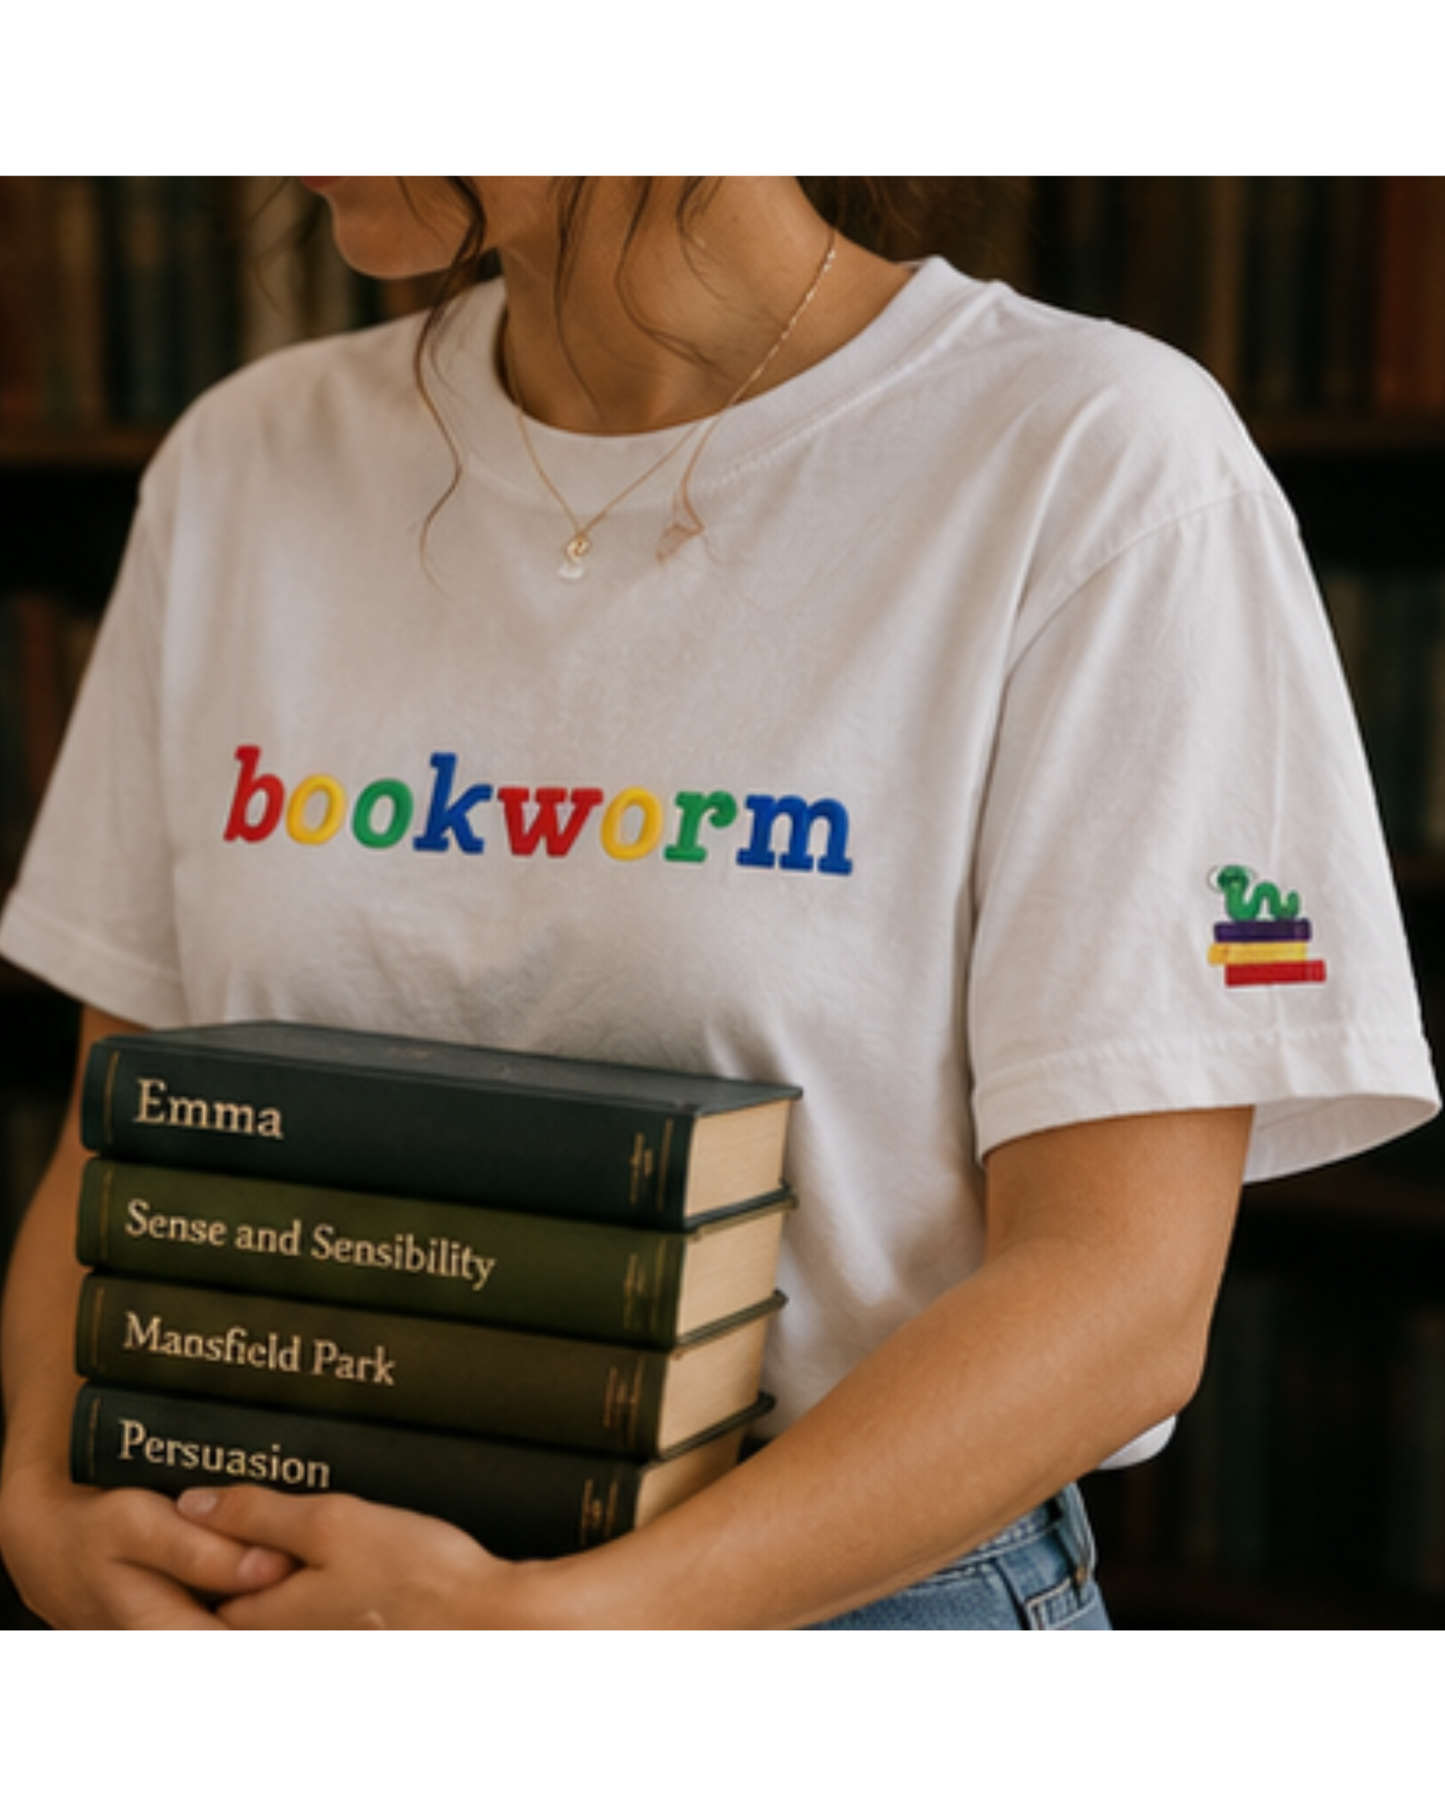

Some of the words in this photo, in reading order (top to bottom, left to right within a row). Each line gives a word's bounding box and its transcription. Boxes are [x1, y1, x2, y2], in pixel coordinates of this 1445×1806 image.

[223, 745, 853, 875] bookworm
[134, 1077, 283, 1140] Emma
[125, 1199, 227, 1246] Sense
[235, 1220, 300, 1256] and
[311, 1224, 496, 1290] Sensibility
[312, 1340, 396, 1386] Park
[118, 1419, 331, 1488] Persuasion
